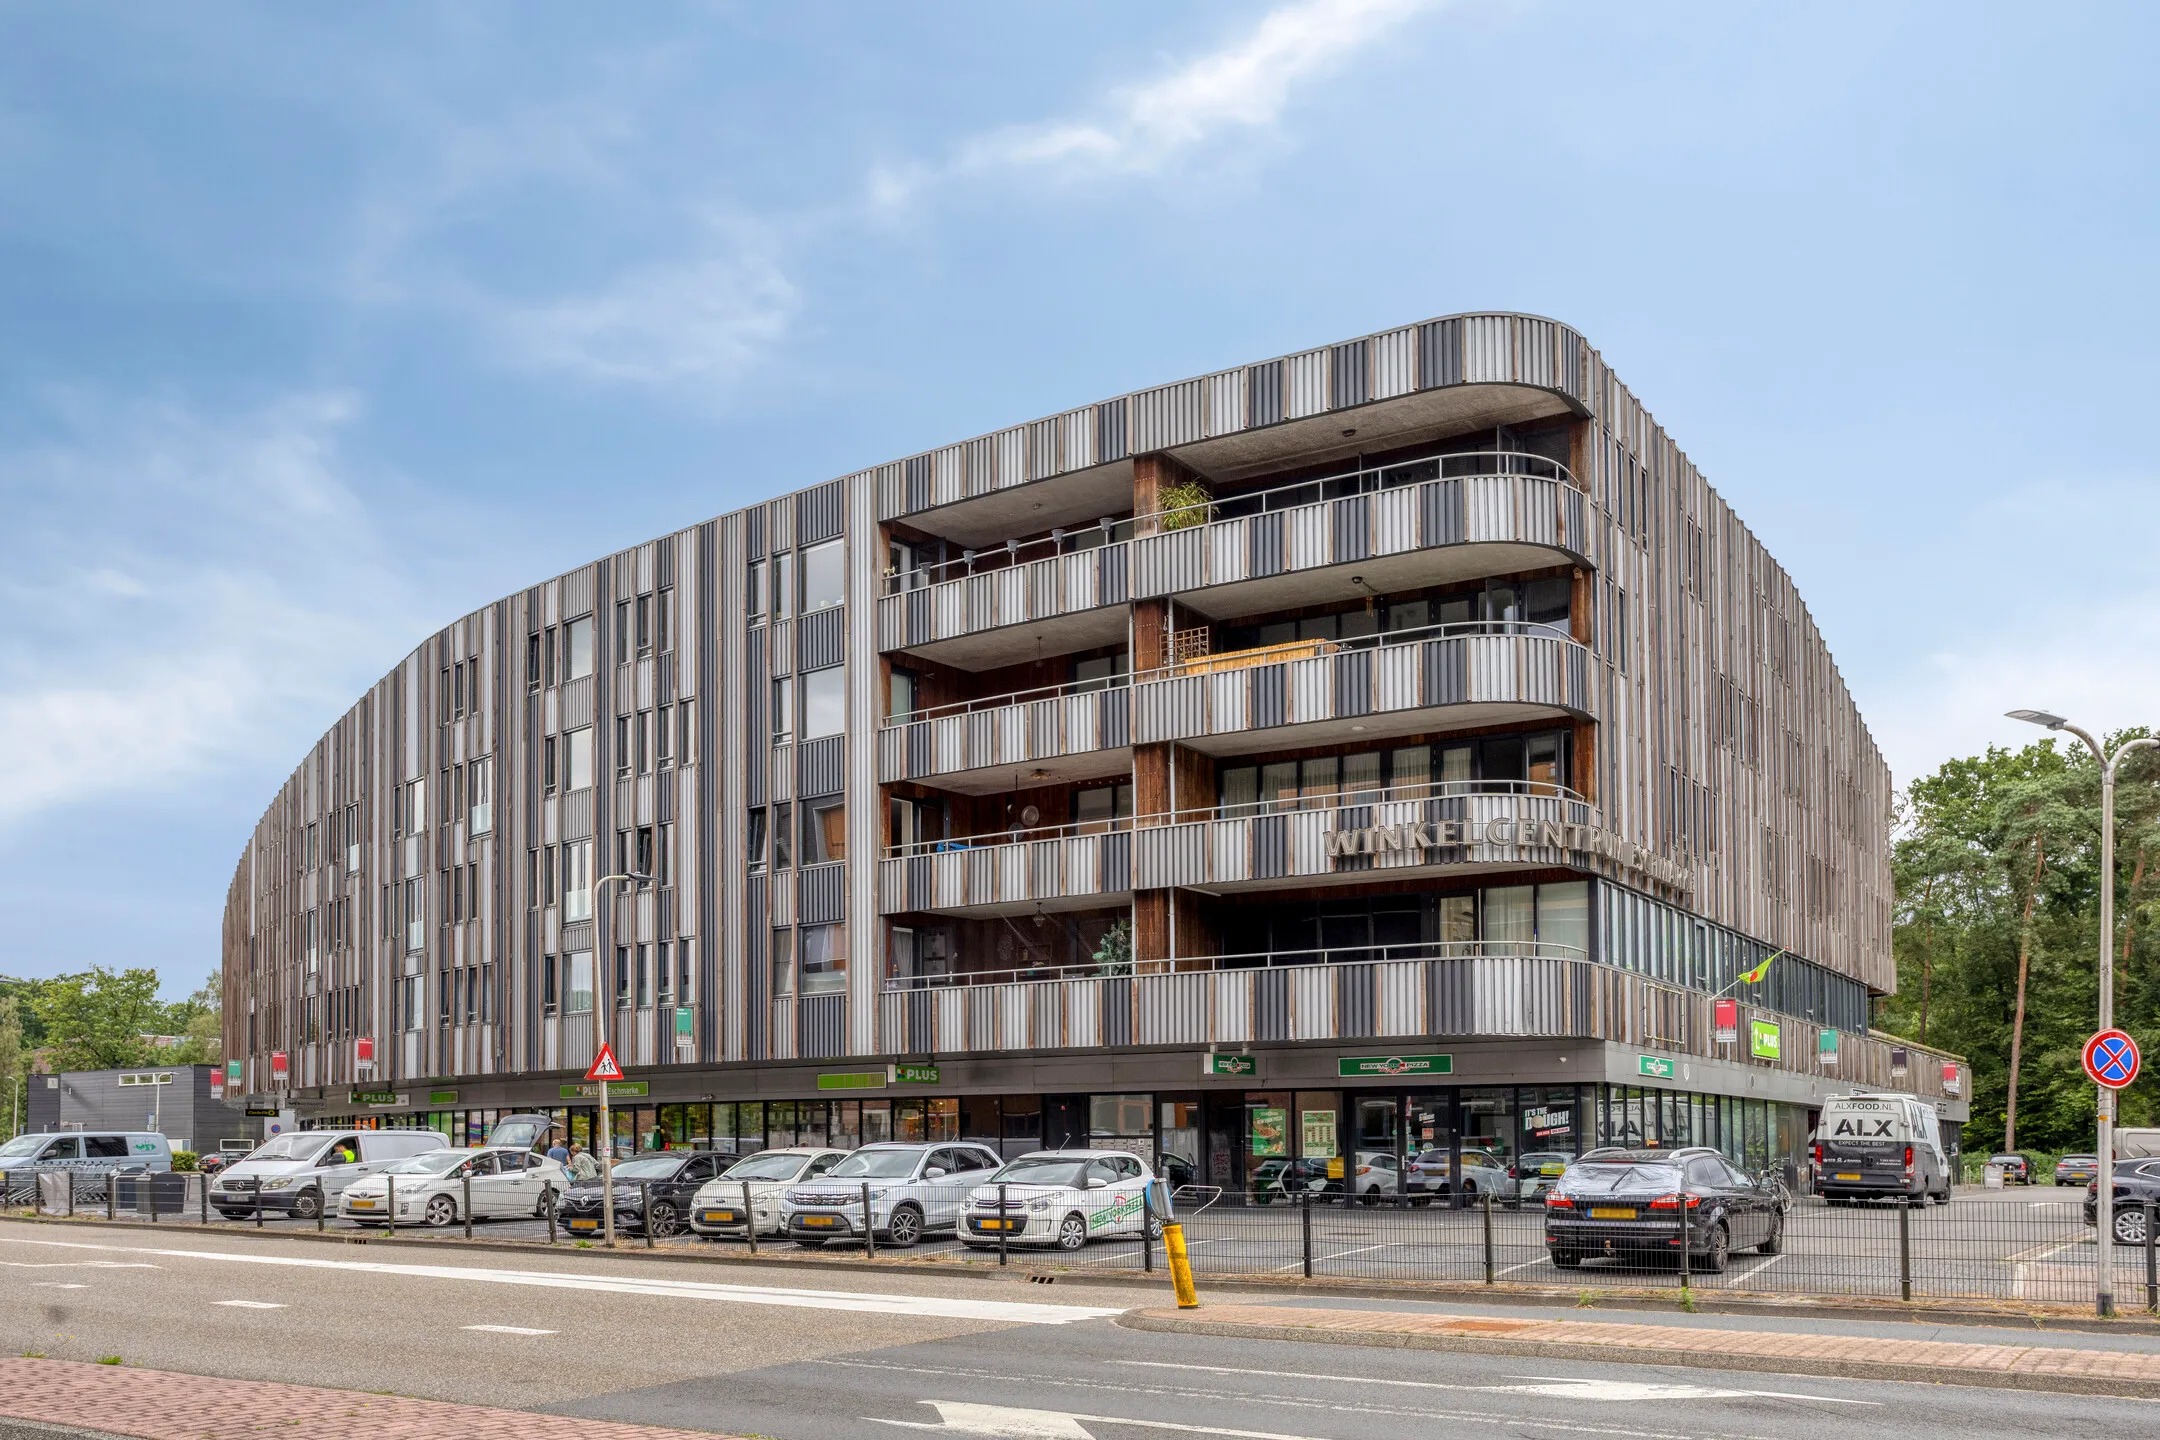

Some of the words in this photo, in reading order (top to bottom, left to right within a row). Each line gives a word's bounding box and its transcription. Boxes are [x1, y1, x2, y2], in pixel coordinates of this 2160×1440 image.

[1764, 1034, 1778, 1049] PLUS
[906, 1068, 937, 1081] PLUS
[362, 1093, 395, 1102] PLUS
[1834, 1102, 1894, 1112] ALXFOOD.NL
[1834, 1118, 1894, 1137] ALX
